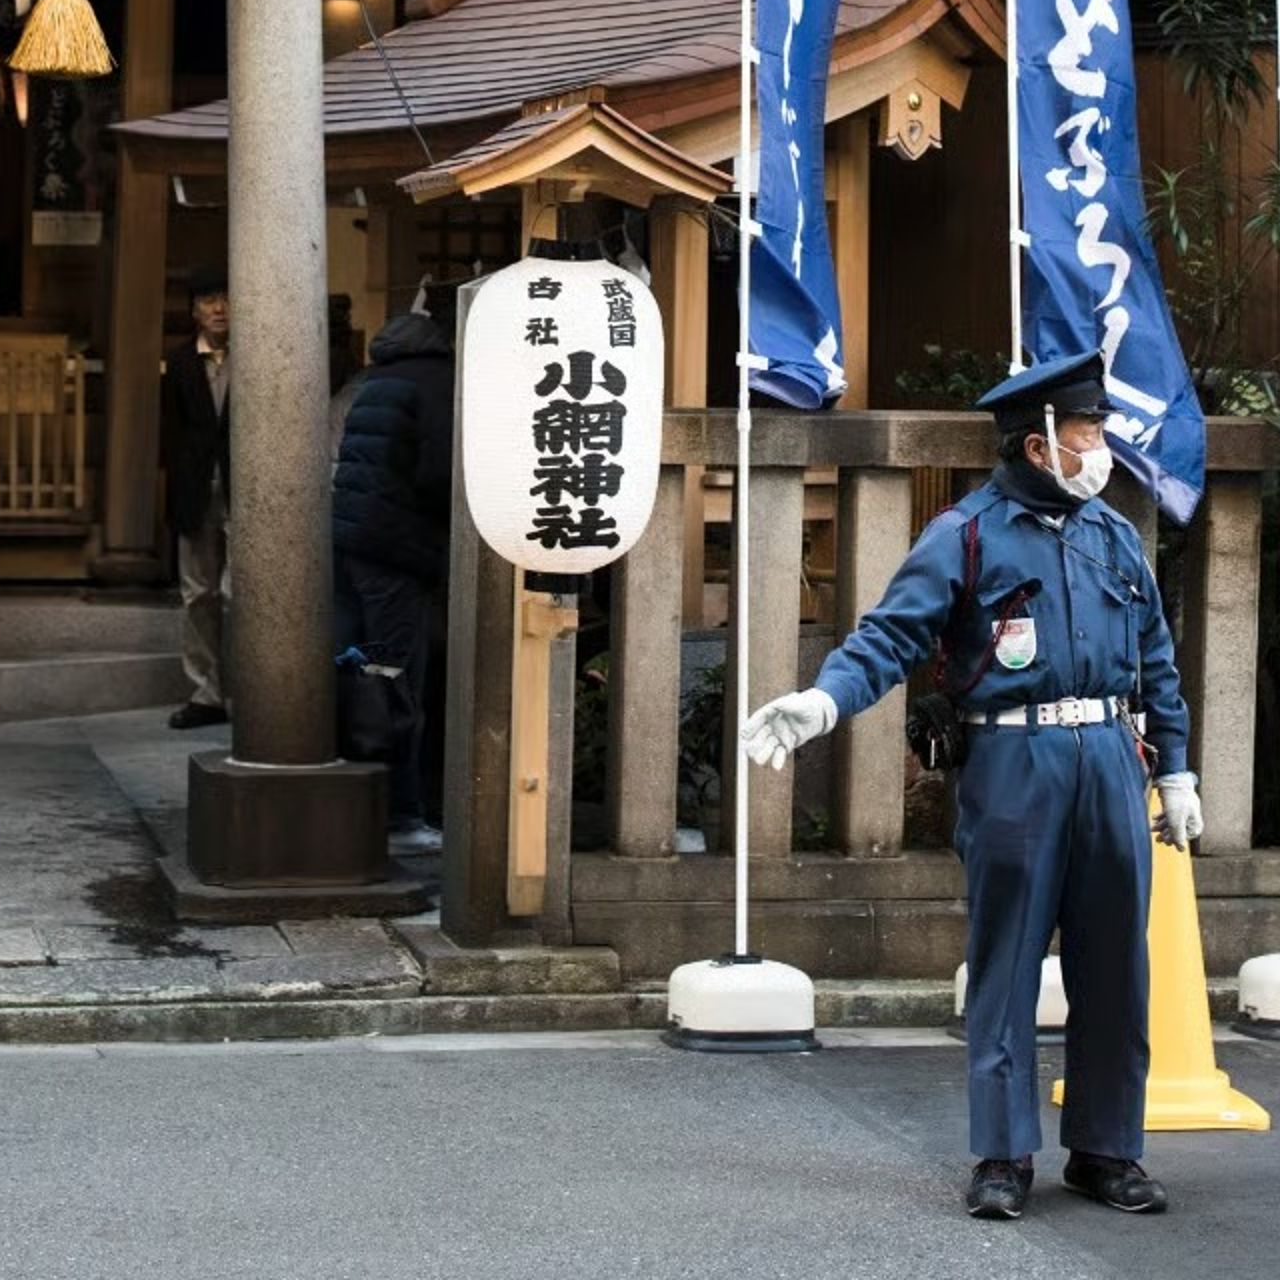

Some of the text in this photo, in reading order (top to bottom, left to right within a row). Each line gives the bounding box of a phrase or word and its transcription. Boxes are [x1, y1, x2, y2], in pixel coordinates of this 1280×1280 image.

[523, 276, 563, 347] 古社
[601, 277, 637, 349] 武蔵国
[524, 350, 628, 551] 小網神社
